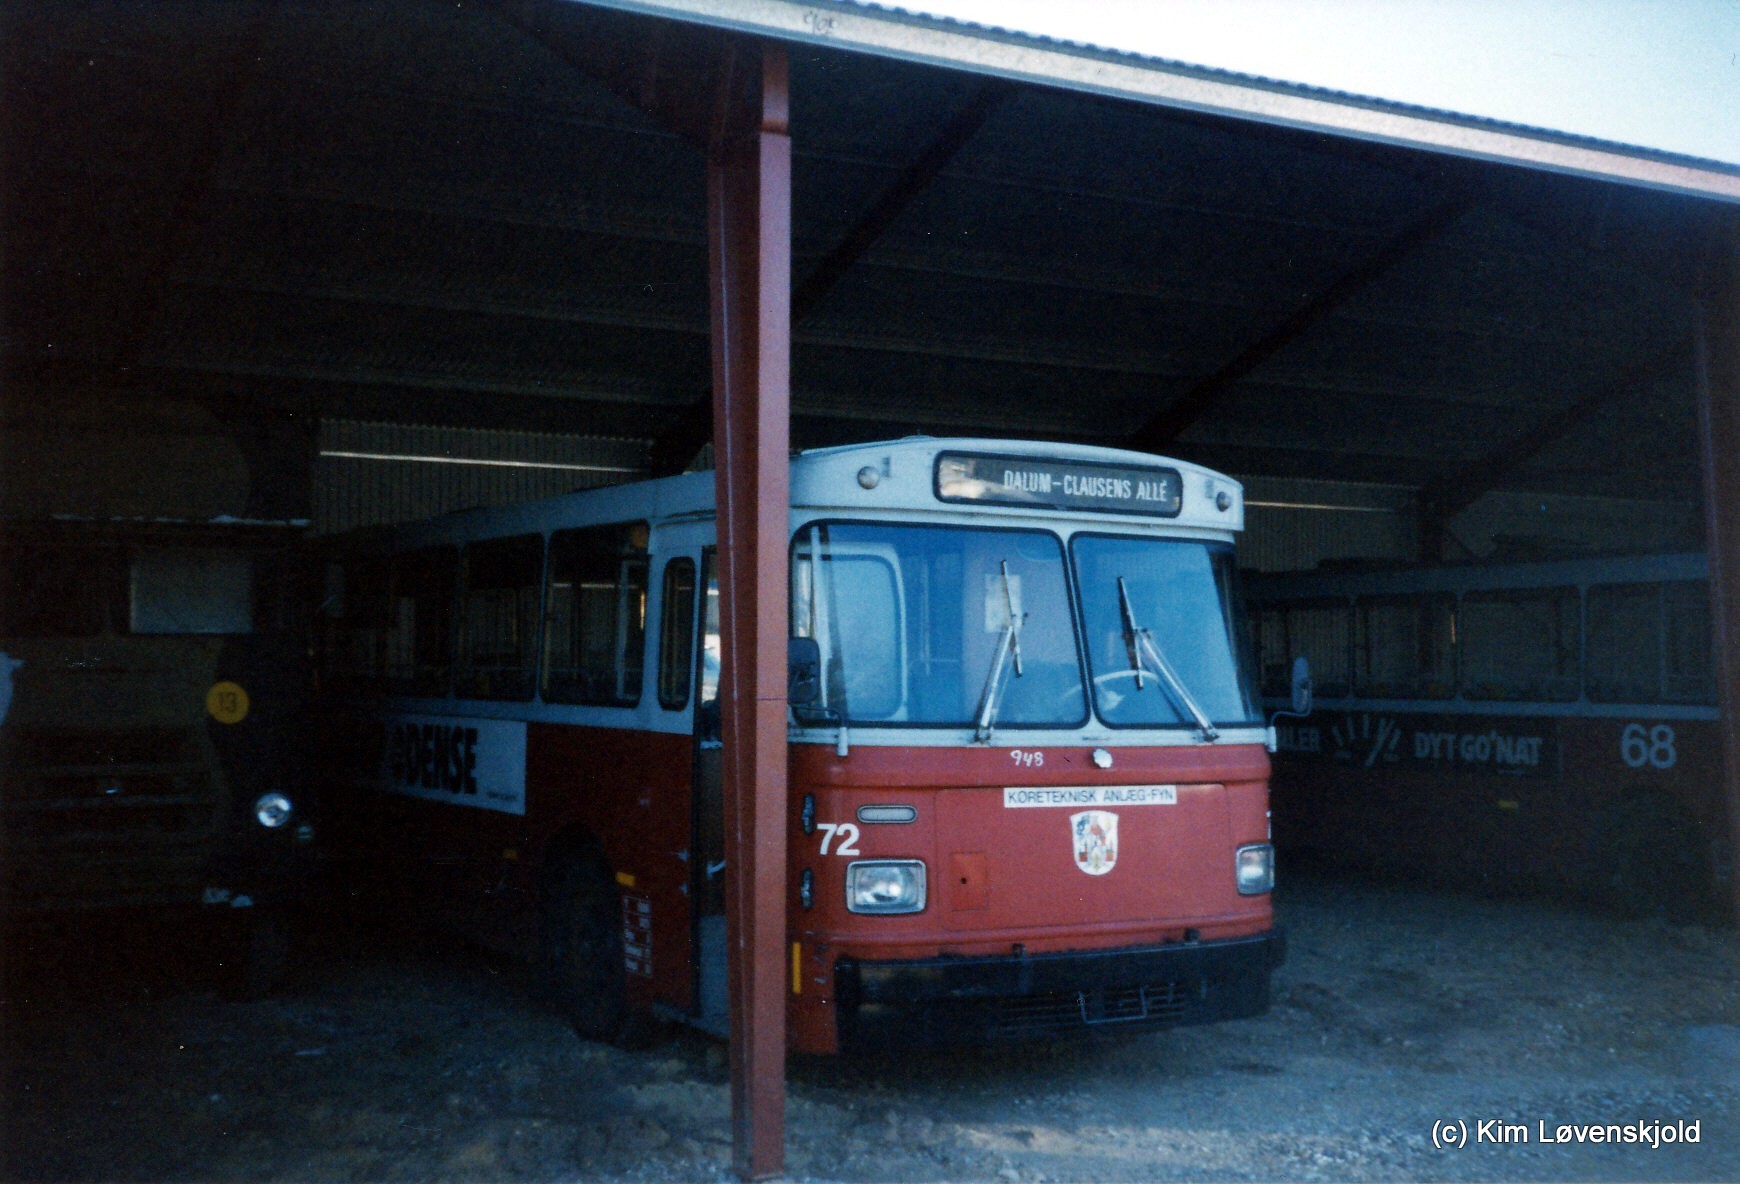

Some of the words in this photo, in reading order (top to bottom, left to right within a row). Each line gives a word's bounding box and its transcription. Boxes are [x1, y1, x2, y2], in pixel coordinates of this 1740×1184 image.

[1136, 479, 1168, 502] ALLÉ
[1010, 749, 1044, 767] 948
[1620, 723, 1677, 769] 68
[816, 823, 861, 856] 72
